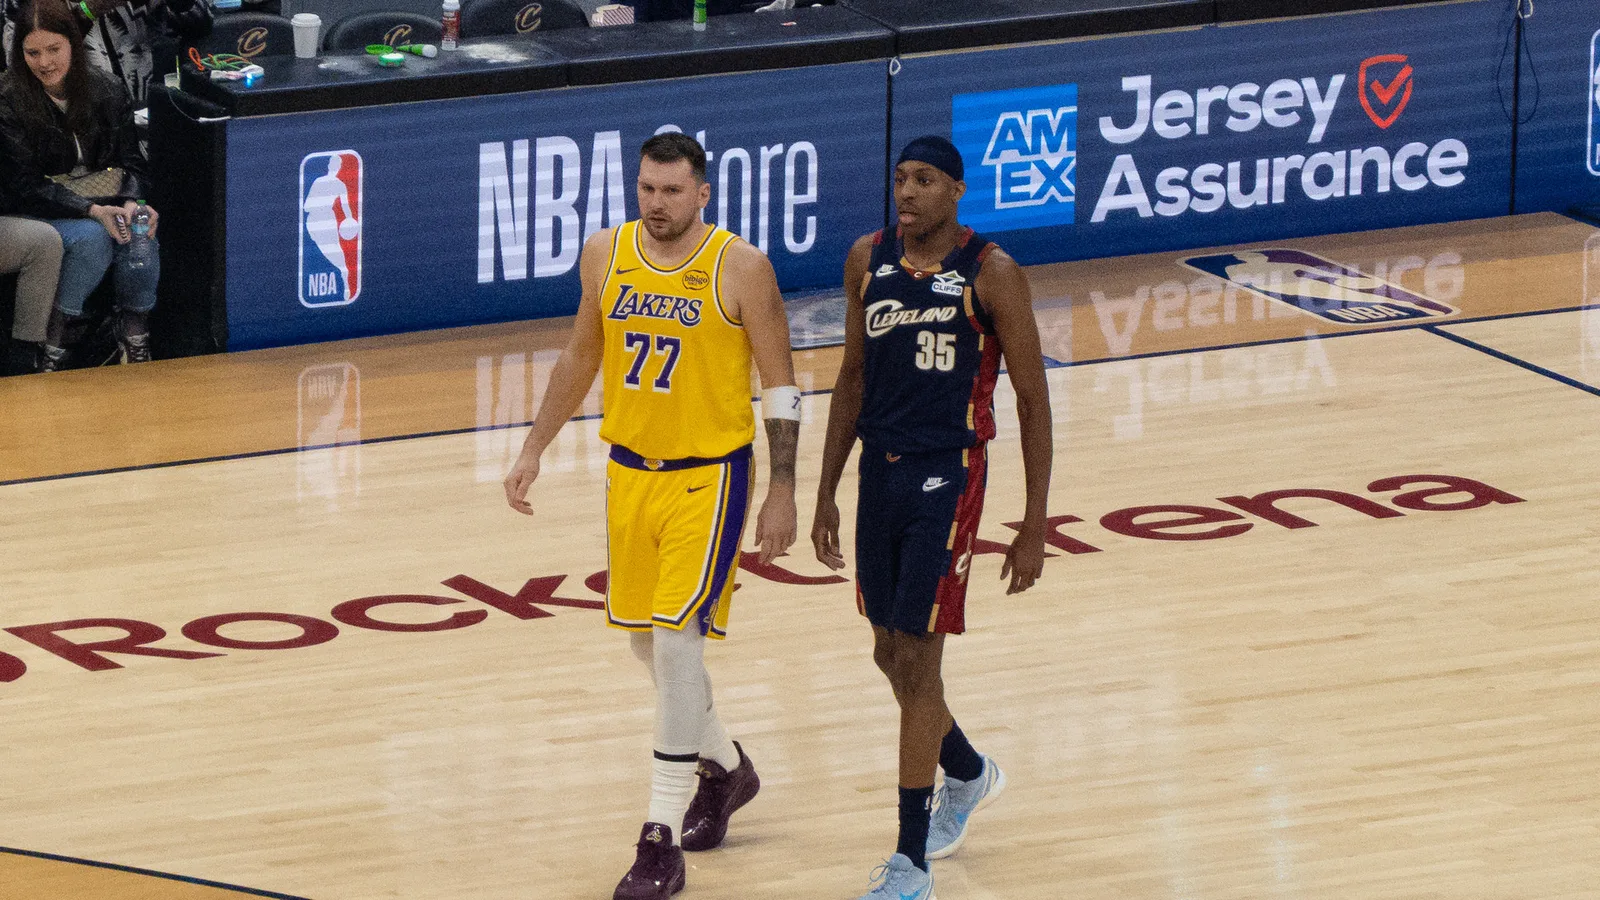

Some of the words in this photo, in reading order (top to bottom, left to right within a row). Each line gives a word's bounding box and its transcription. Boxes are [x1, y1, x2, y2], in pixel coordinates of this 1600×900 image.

[1099, 74, 1346, 143] Jersey
[1090, 138, 1468, 223] Assurance
[477, 129, 626, 283] NBA
[654, 124, 818, 253] ore
[308, 272, 337, 297] NBA
[684, 275, 708, 285] bibigo
[933, 283, 962, 294] CLIFFS
[607, 284, 703, 327] LAKERS
[865, 299, 957, 337] CLEVELAND
[1326, 304, 1410, 321] NBA
[624, 331, 681, 393] 77
[915, 330, 957, 372] 35
